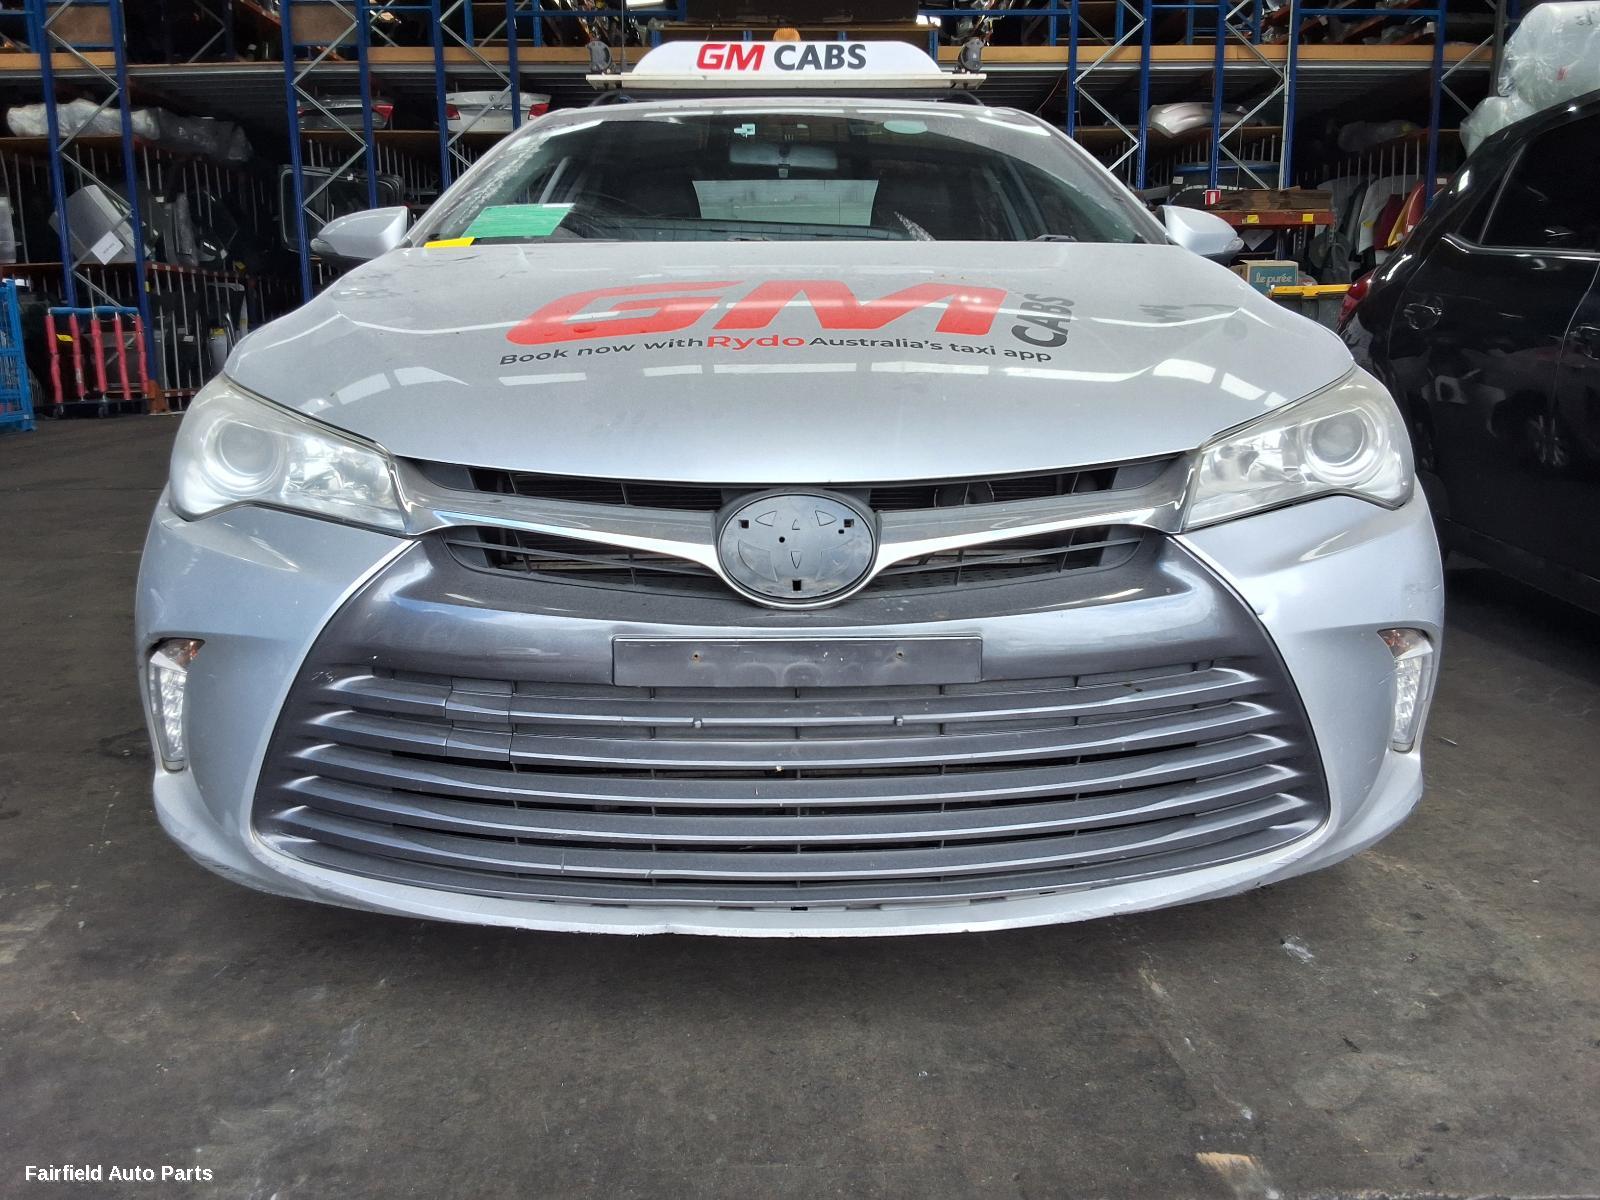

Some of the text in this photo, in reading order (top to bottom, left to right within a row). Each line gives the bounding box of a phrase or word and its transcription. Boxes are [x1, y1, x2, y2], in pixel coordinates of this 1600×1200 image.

[696, 43, 867, 71] GM CABS
[505, 280, 1007, 345] GM
[1011, 293, 1075, 348] CABS
[499, 348, 568, 365] Book
[577, 343, 636, 356] now
[643, 337, 703, 350] with
[706, 334, 804, 351] Rydo
[949, 342, 997, 356] taxi
[1003, 348, 1052, 363] app
